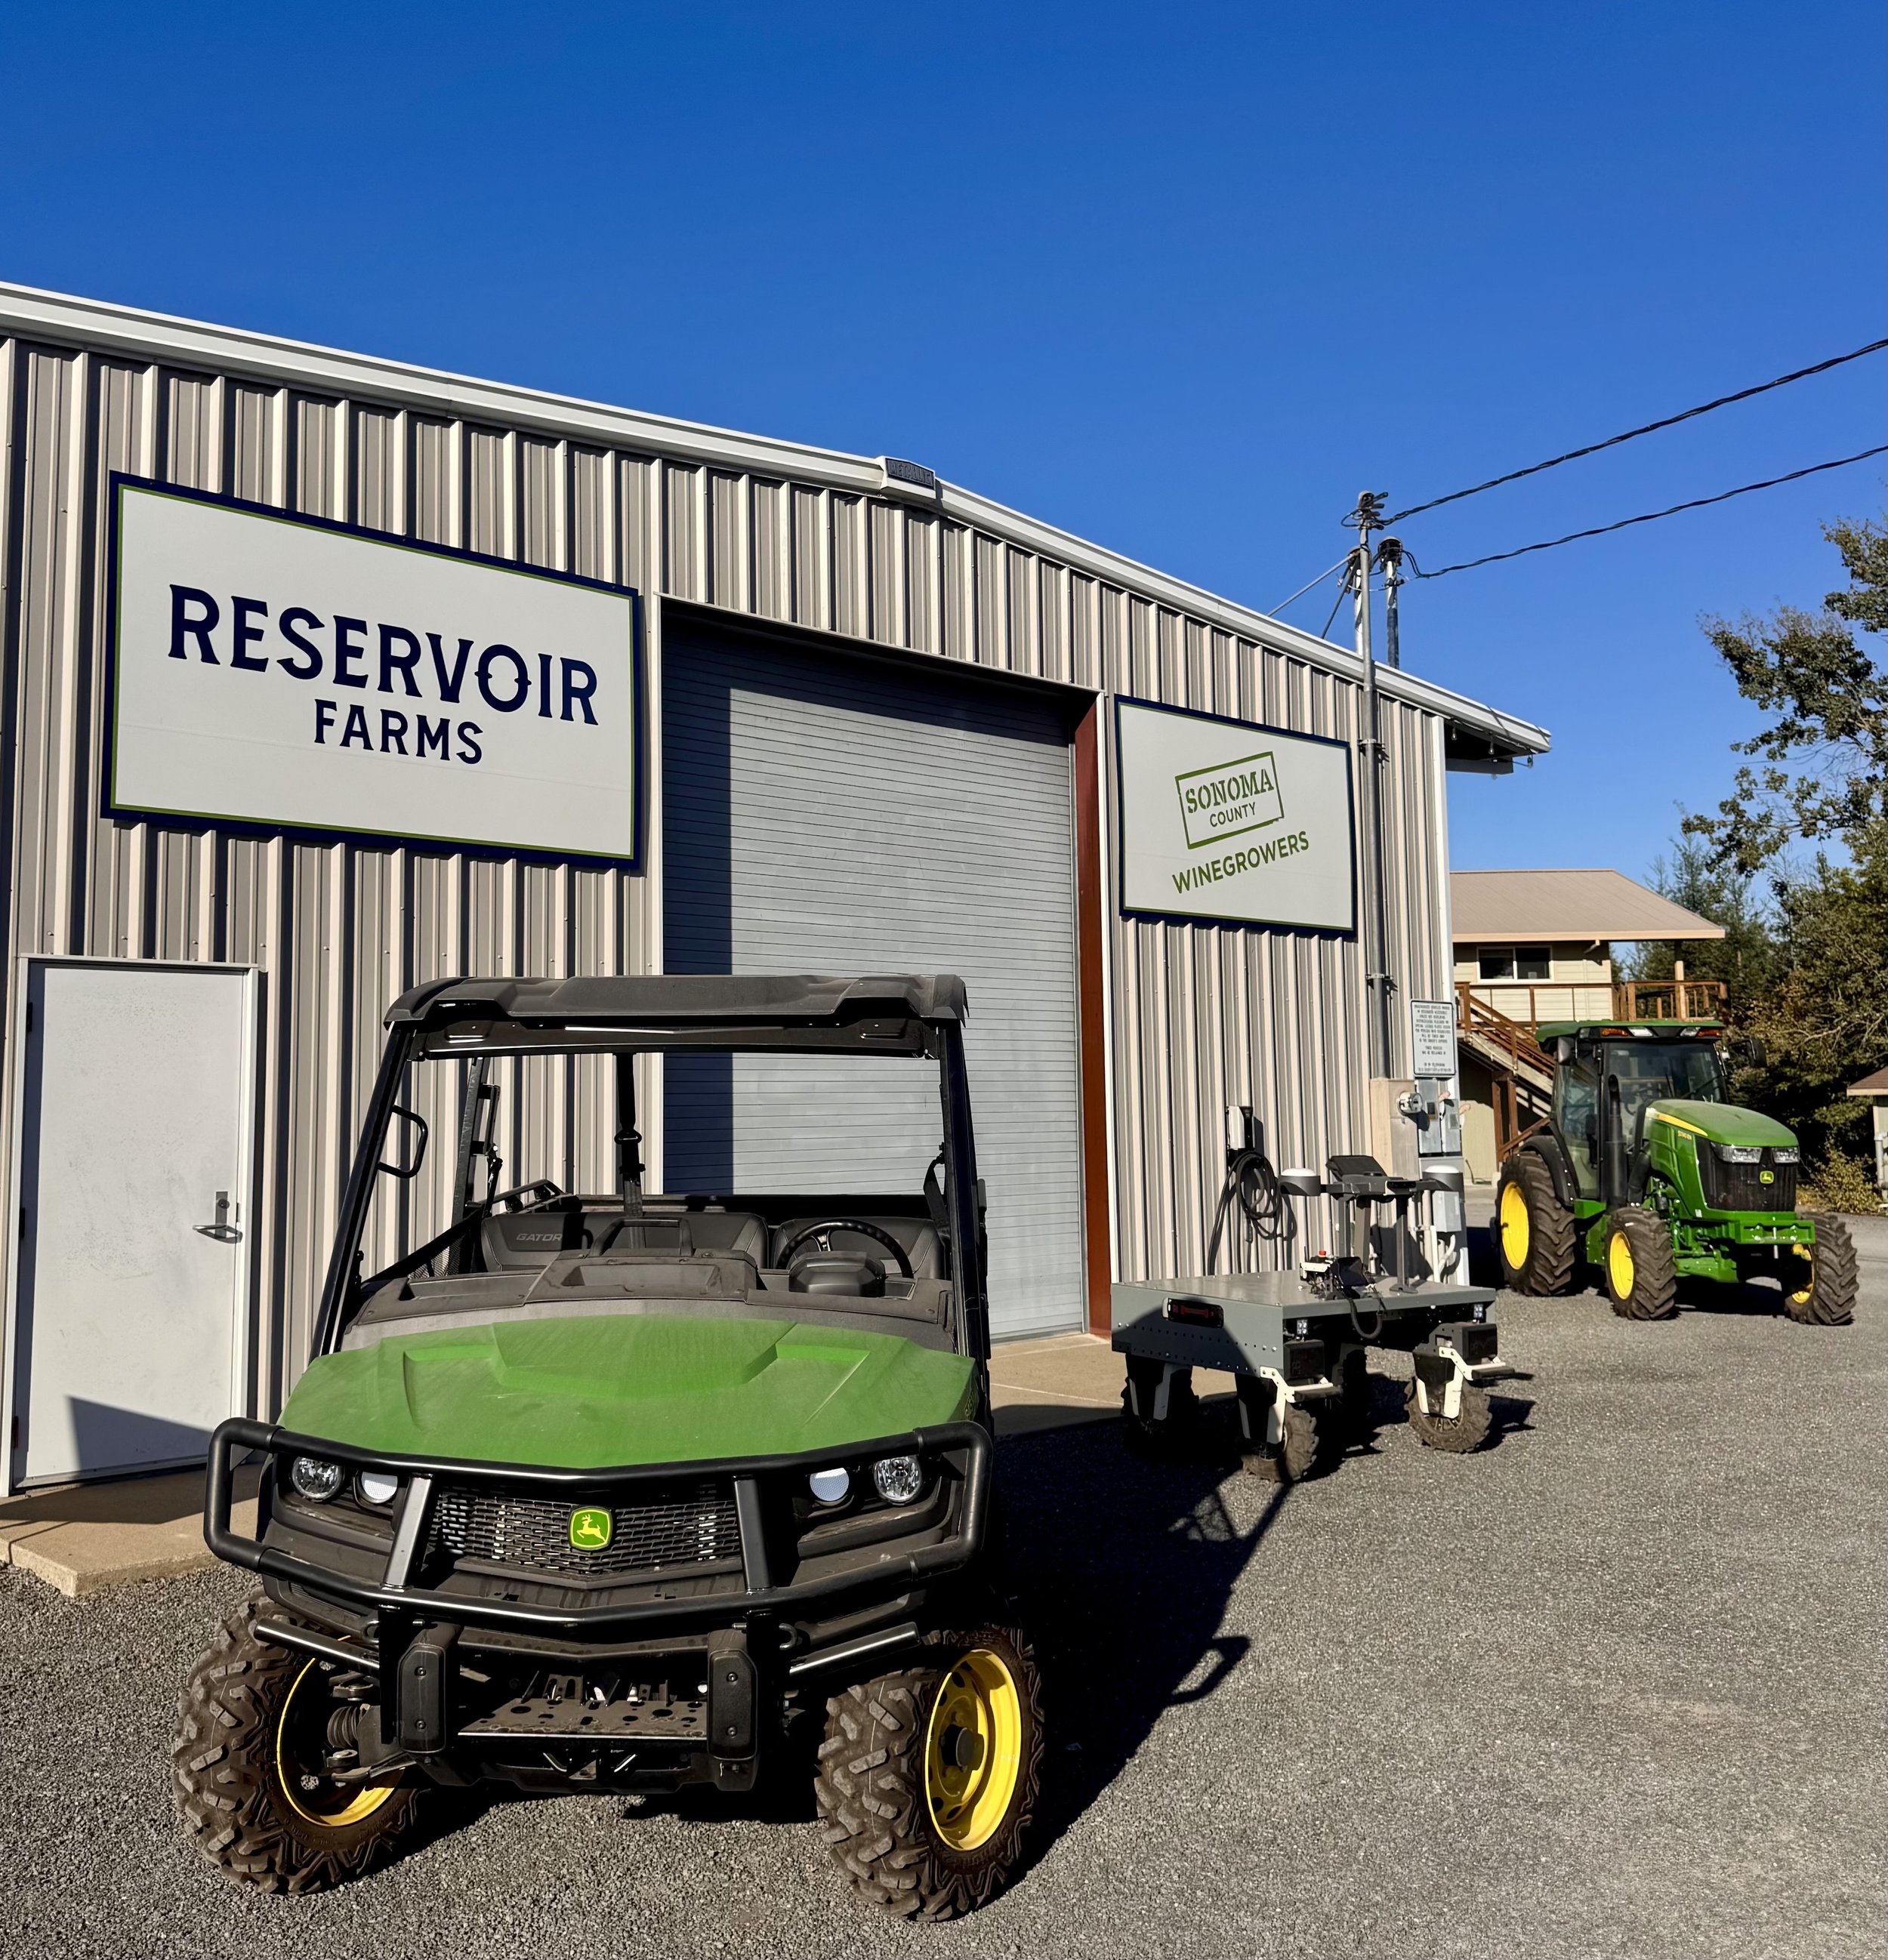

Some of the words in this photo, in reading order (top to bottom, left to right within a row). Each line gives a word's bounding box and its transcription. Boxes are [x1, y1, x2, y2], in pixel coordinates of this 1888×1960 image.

[168, 584, 599, 726] RESERVOIR
[313, 698, 484, 765] FARMS
[1185, 768, 1275, 814] SONOMA
[1209, 801, 1256, 828] COUNTY
[1171, 831, 1309, 893] WINEGROWERS
[516, 1233, 563, 1242] GATOR
